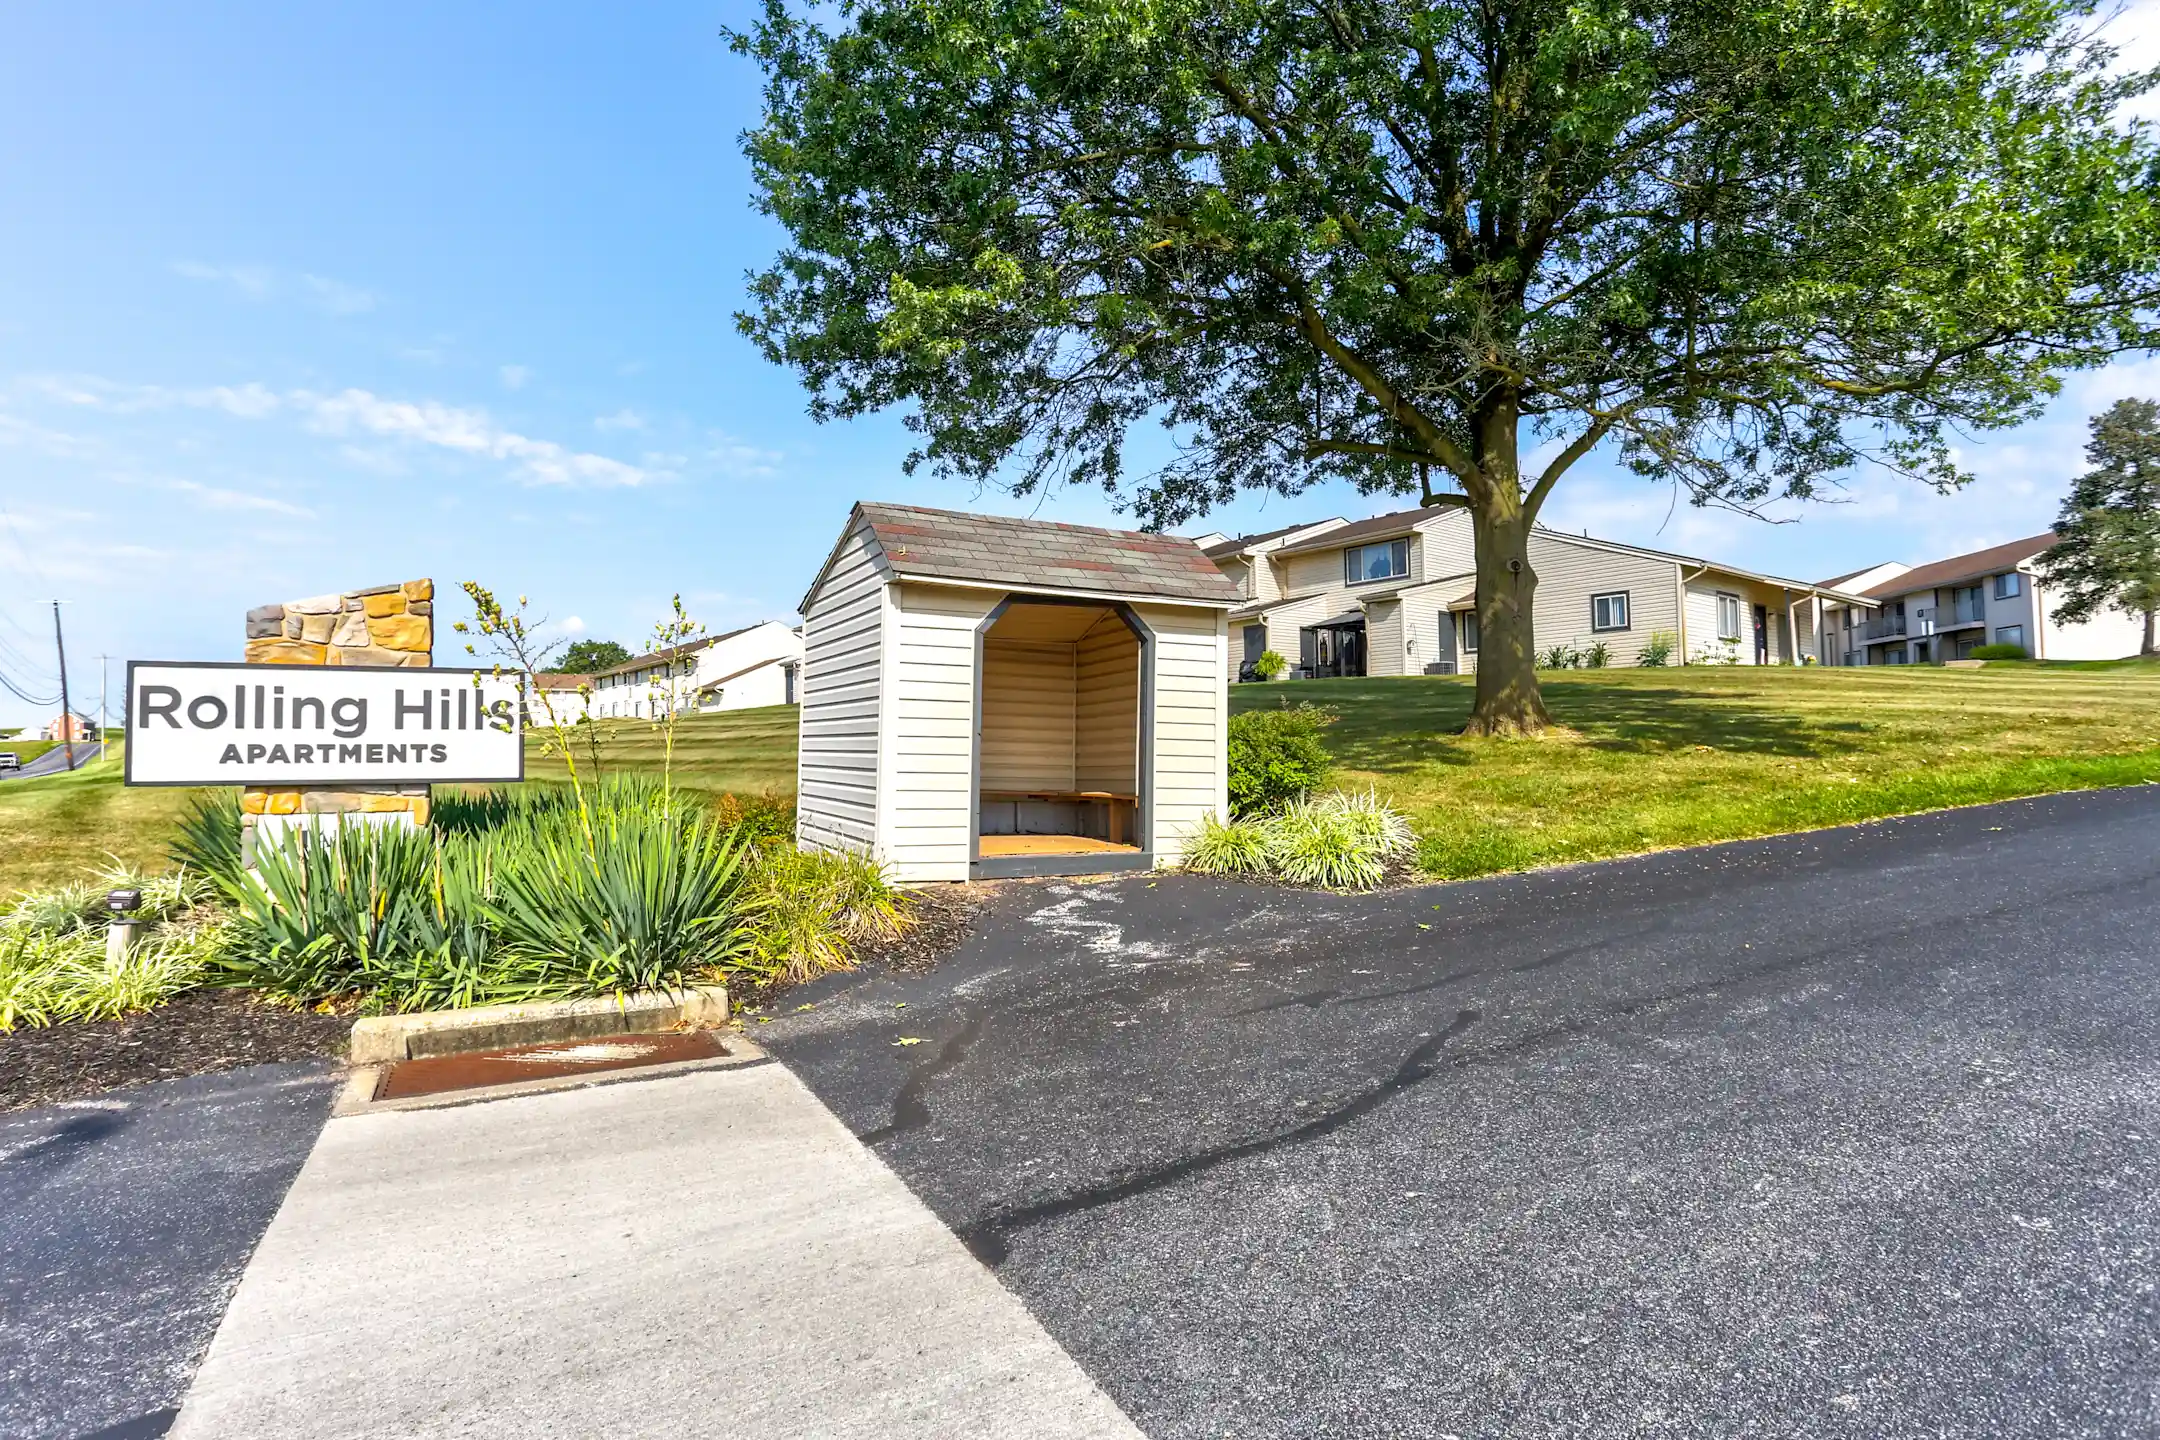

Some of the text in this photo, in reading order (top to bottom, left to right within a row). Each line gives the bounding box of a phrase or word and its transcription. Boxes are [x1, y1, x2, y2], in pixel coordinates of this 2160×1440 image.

[139, 685, 515, 739] Rolling Hills
[219, 743, 448, 764] APARTMENTS
